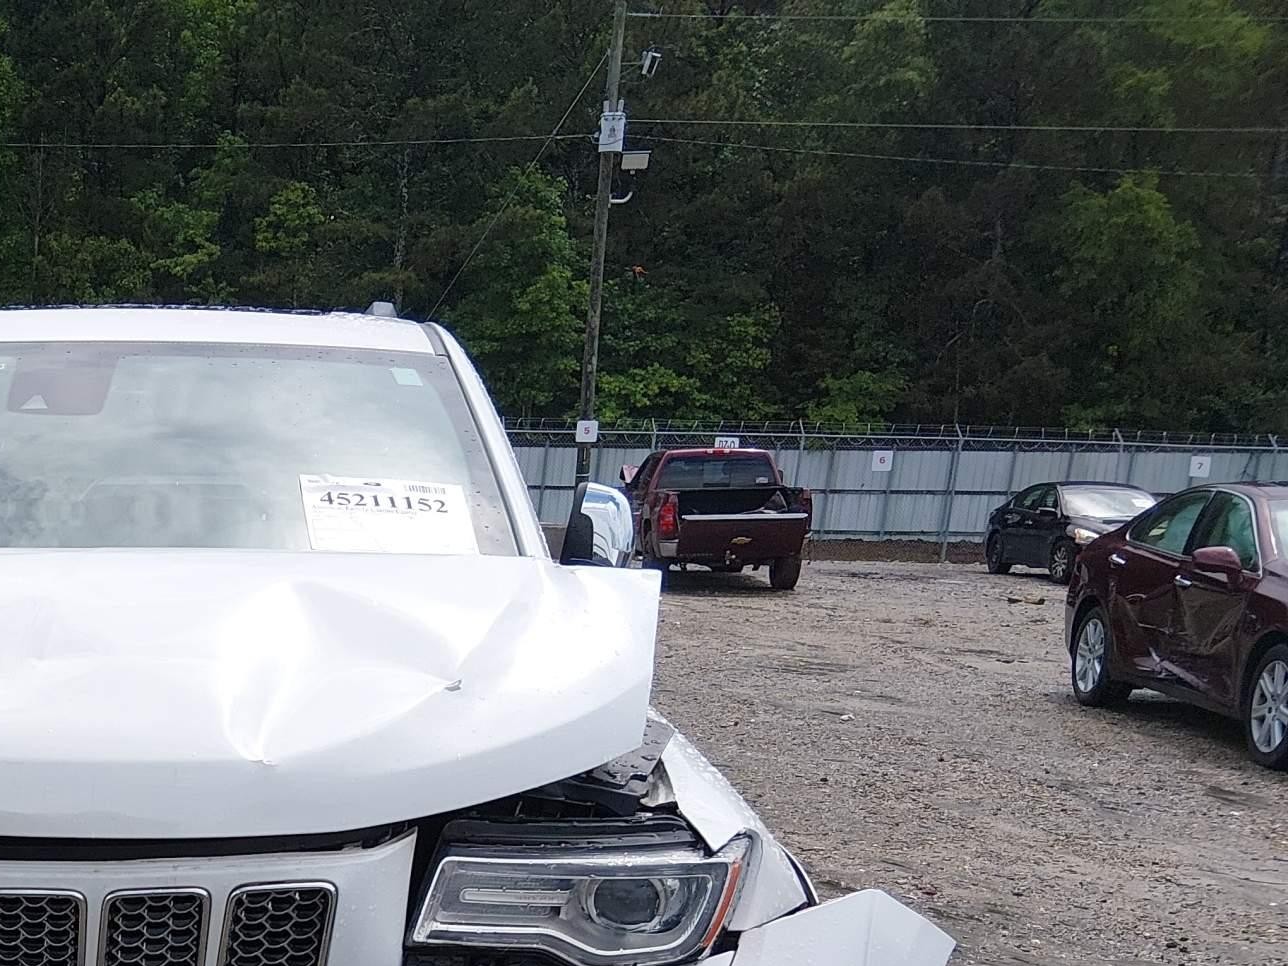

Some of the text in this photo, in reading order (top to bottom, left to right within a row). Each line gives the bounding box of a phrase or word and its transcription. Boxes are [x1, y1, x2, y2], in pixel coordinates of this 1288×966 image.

[583, 426, 591, 435] 5
[879, 456, 886, 465] 6
[1197, 462, 1204, 471] 7
[320, 490, 449, 514] 45211152
